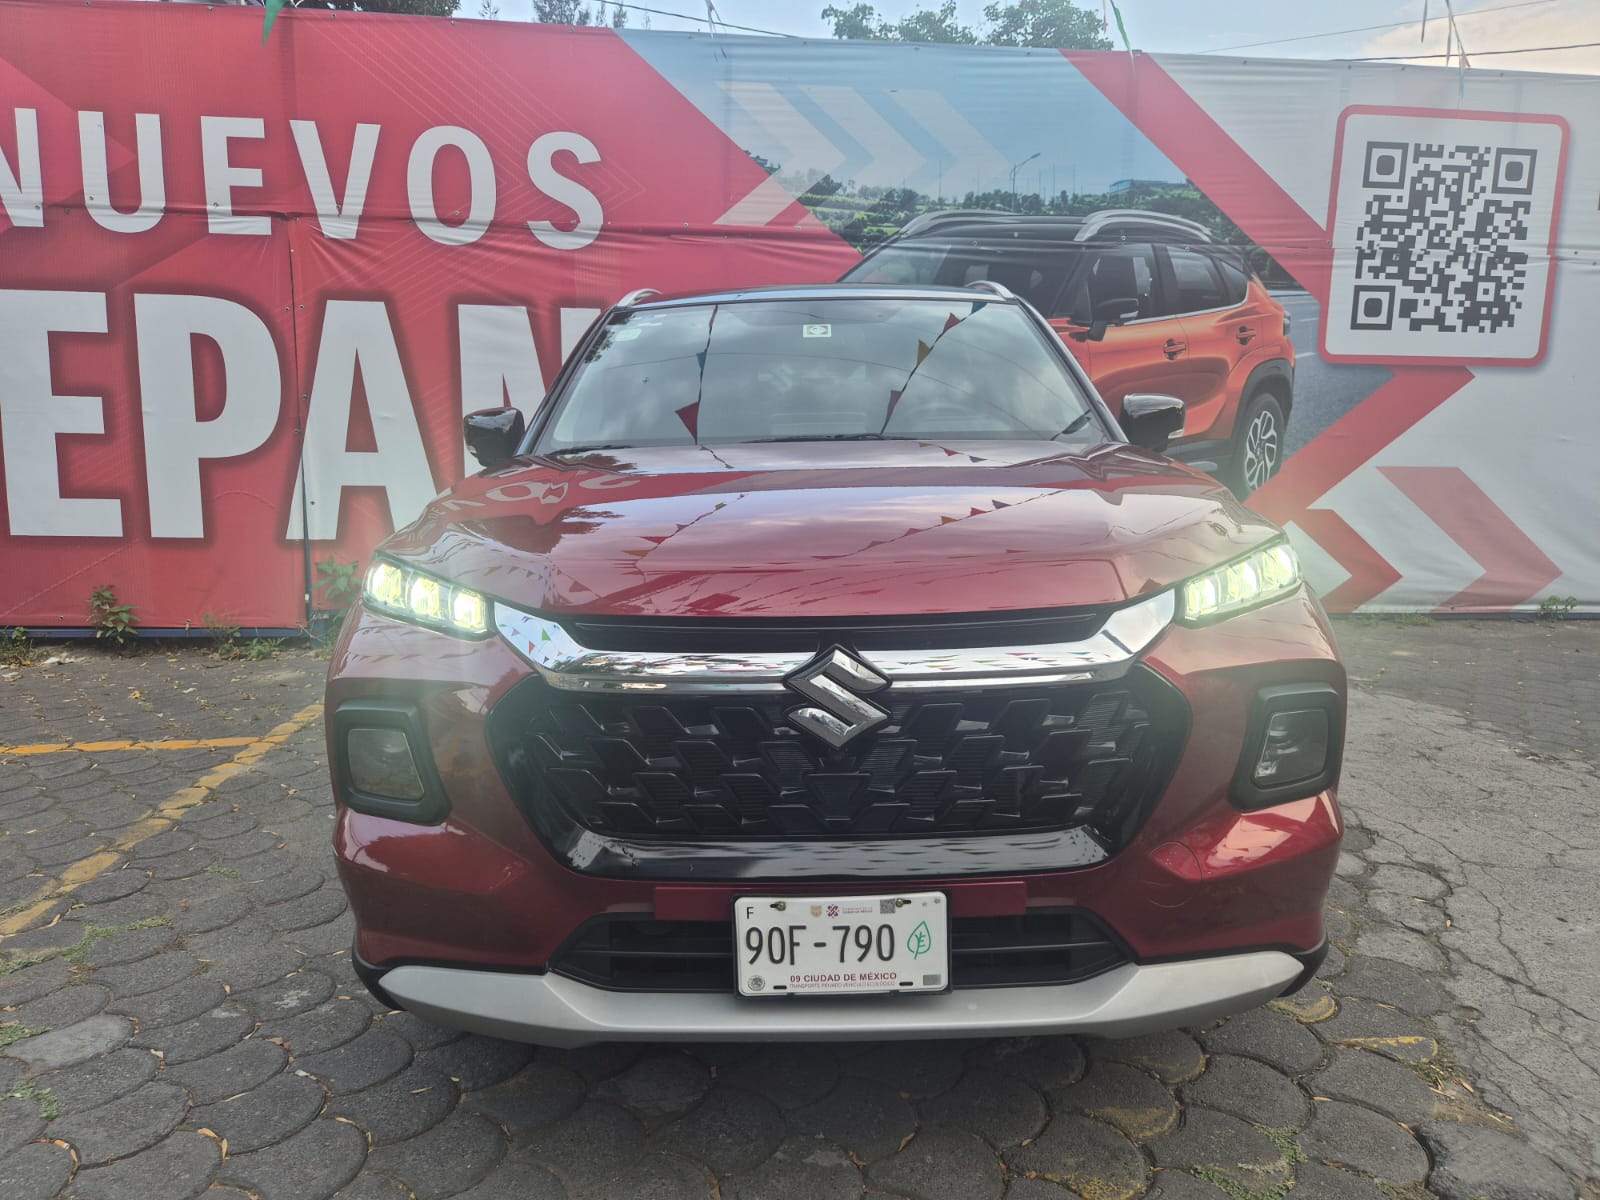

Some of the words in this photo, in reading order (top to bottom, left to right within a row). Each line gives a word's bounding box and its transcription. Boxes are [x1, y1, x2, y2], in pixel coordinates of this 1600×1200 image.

[746, 906, 754, 920] F
[745, 923, 896, 966] 90F-790
[790, 975, 801, 983] 09
[803, 974, 841, 983] CIUDAD
[843, 973, 857, 982] DE
